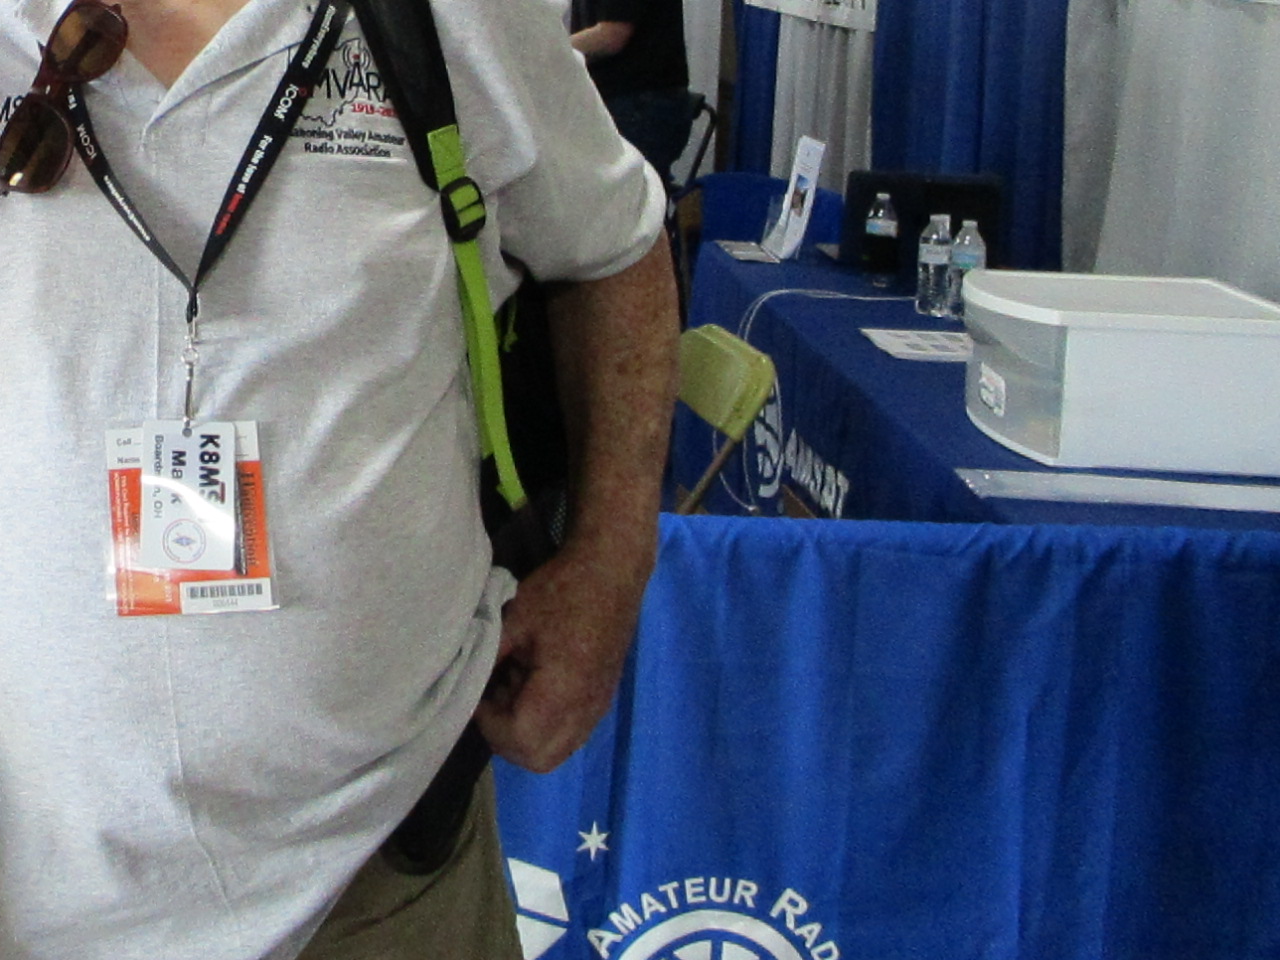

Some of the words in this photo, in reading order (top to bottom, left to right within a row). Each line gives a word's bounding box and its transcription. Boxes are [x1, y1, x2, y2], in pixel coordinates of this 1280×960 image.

[304, 142, 334, 155] Radio
[170, 450, 187, 505] Mak
[587, 876, 759, 960] AMATEUR
